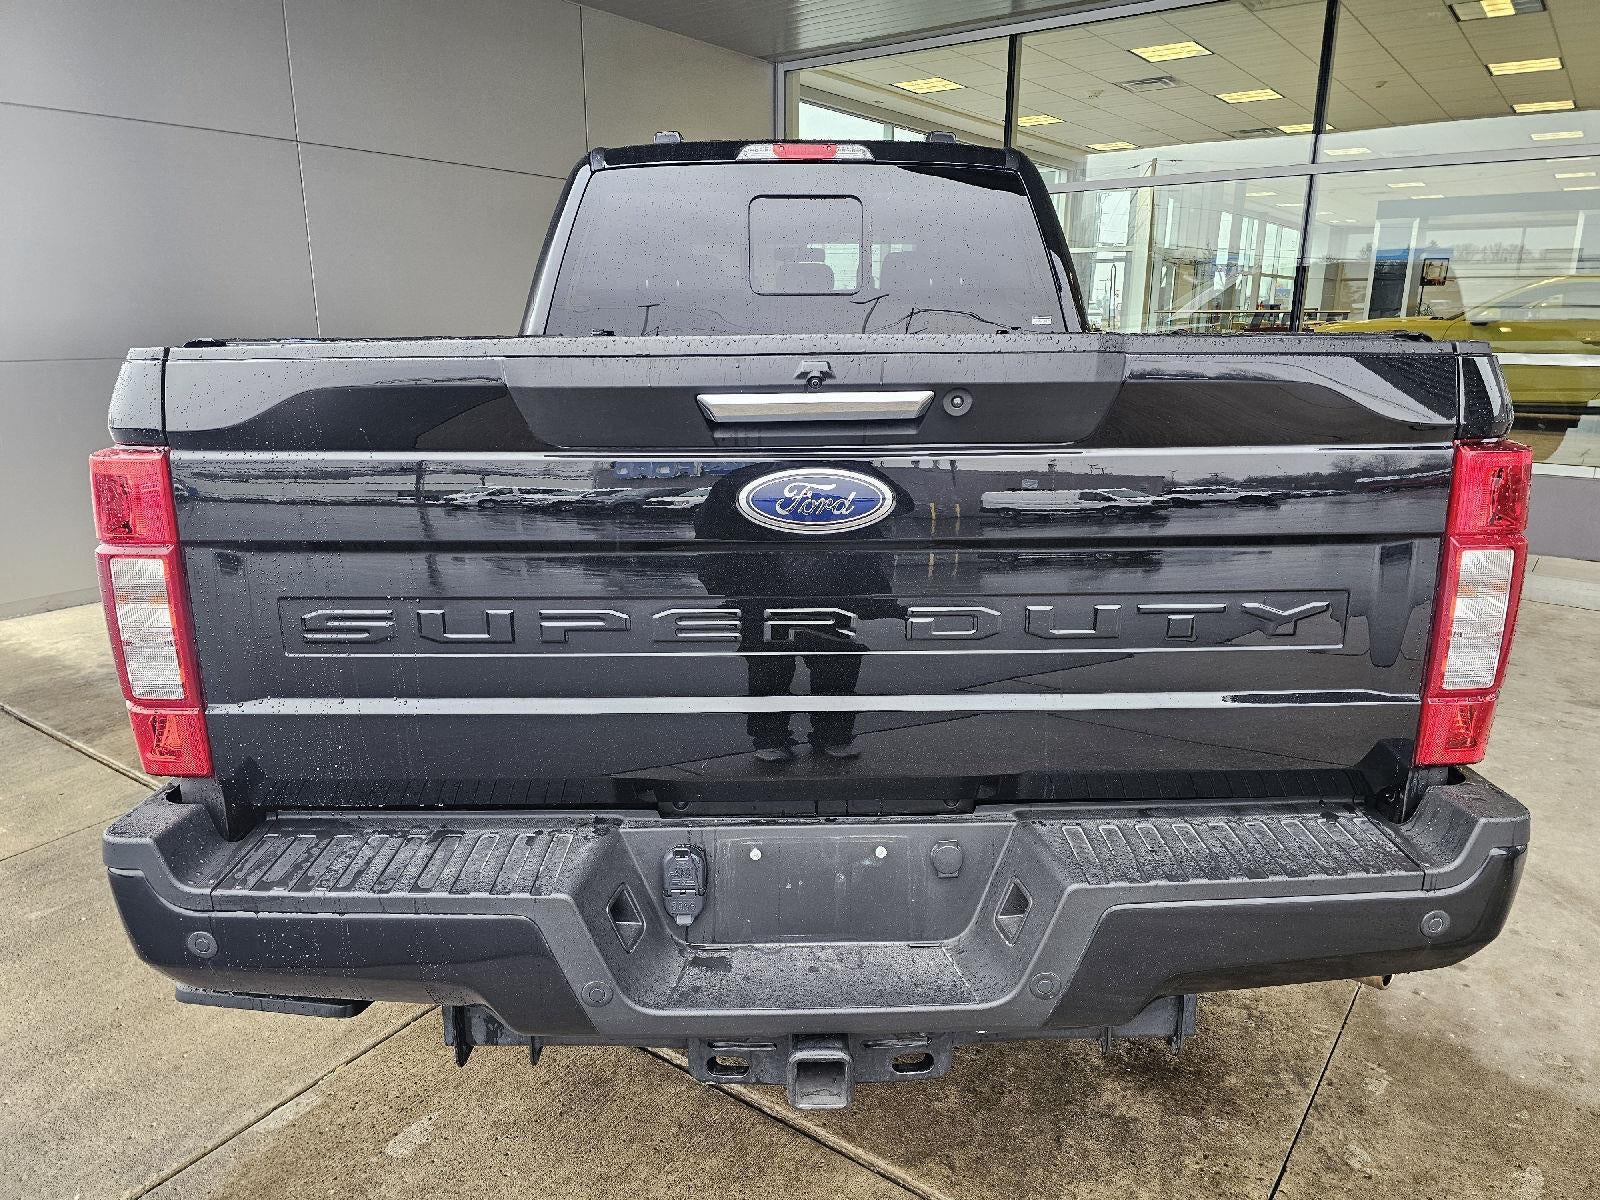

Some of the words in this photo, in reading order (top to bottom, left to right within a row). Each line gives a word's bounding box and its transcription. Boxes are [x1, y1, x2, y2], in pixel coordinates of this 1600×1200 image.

[775, 482, 857, 515] Ford
[302, 608, 858, 643] SUPER
[905, 601, 1331, 641] DUTY
